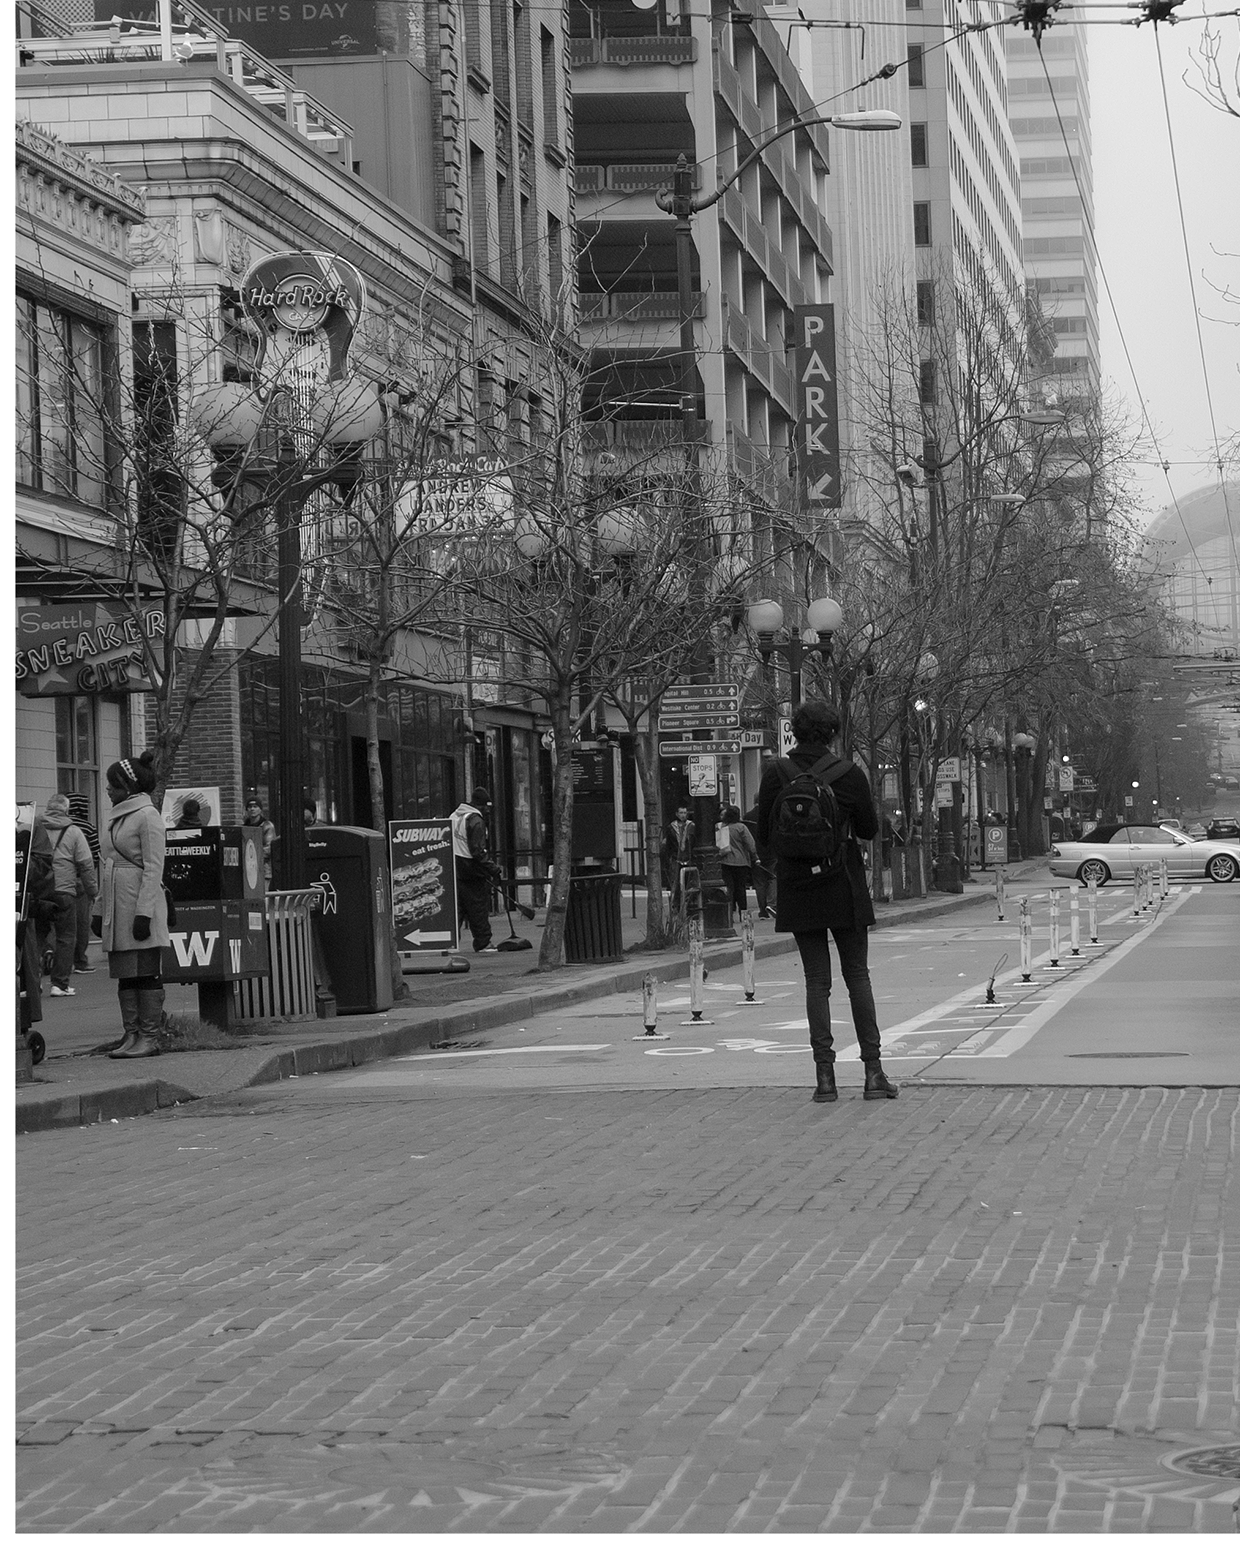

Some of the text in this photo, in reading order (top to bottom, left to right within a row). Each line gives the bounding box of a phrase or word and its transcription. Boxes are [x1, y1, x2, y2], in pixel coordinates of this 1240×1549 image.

[302, 3, 349, 20] DAY
[250, 284, 346, 307] Hard Rock
[801, 316, 831, 456] PARK
[20, 610, 92, 633] Seattle
[16, 610, 165, 678] SNEAKER
[77, 651, 149, 691] CITY
[745, 733, 761, 743] Day
[392, 827, 451, 844] SUBWAY
[187, 845, 211, 856] WEEKLY
[412, 848, 425, 856] eat
[169, 930, 220, 967] W
[228, 939, 241, 974] W
